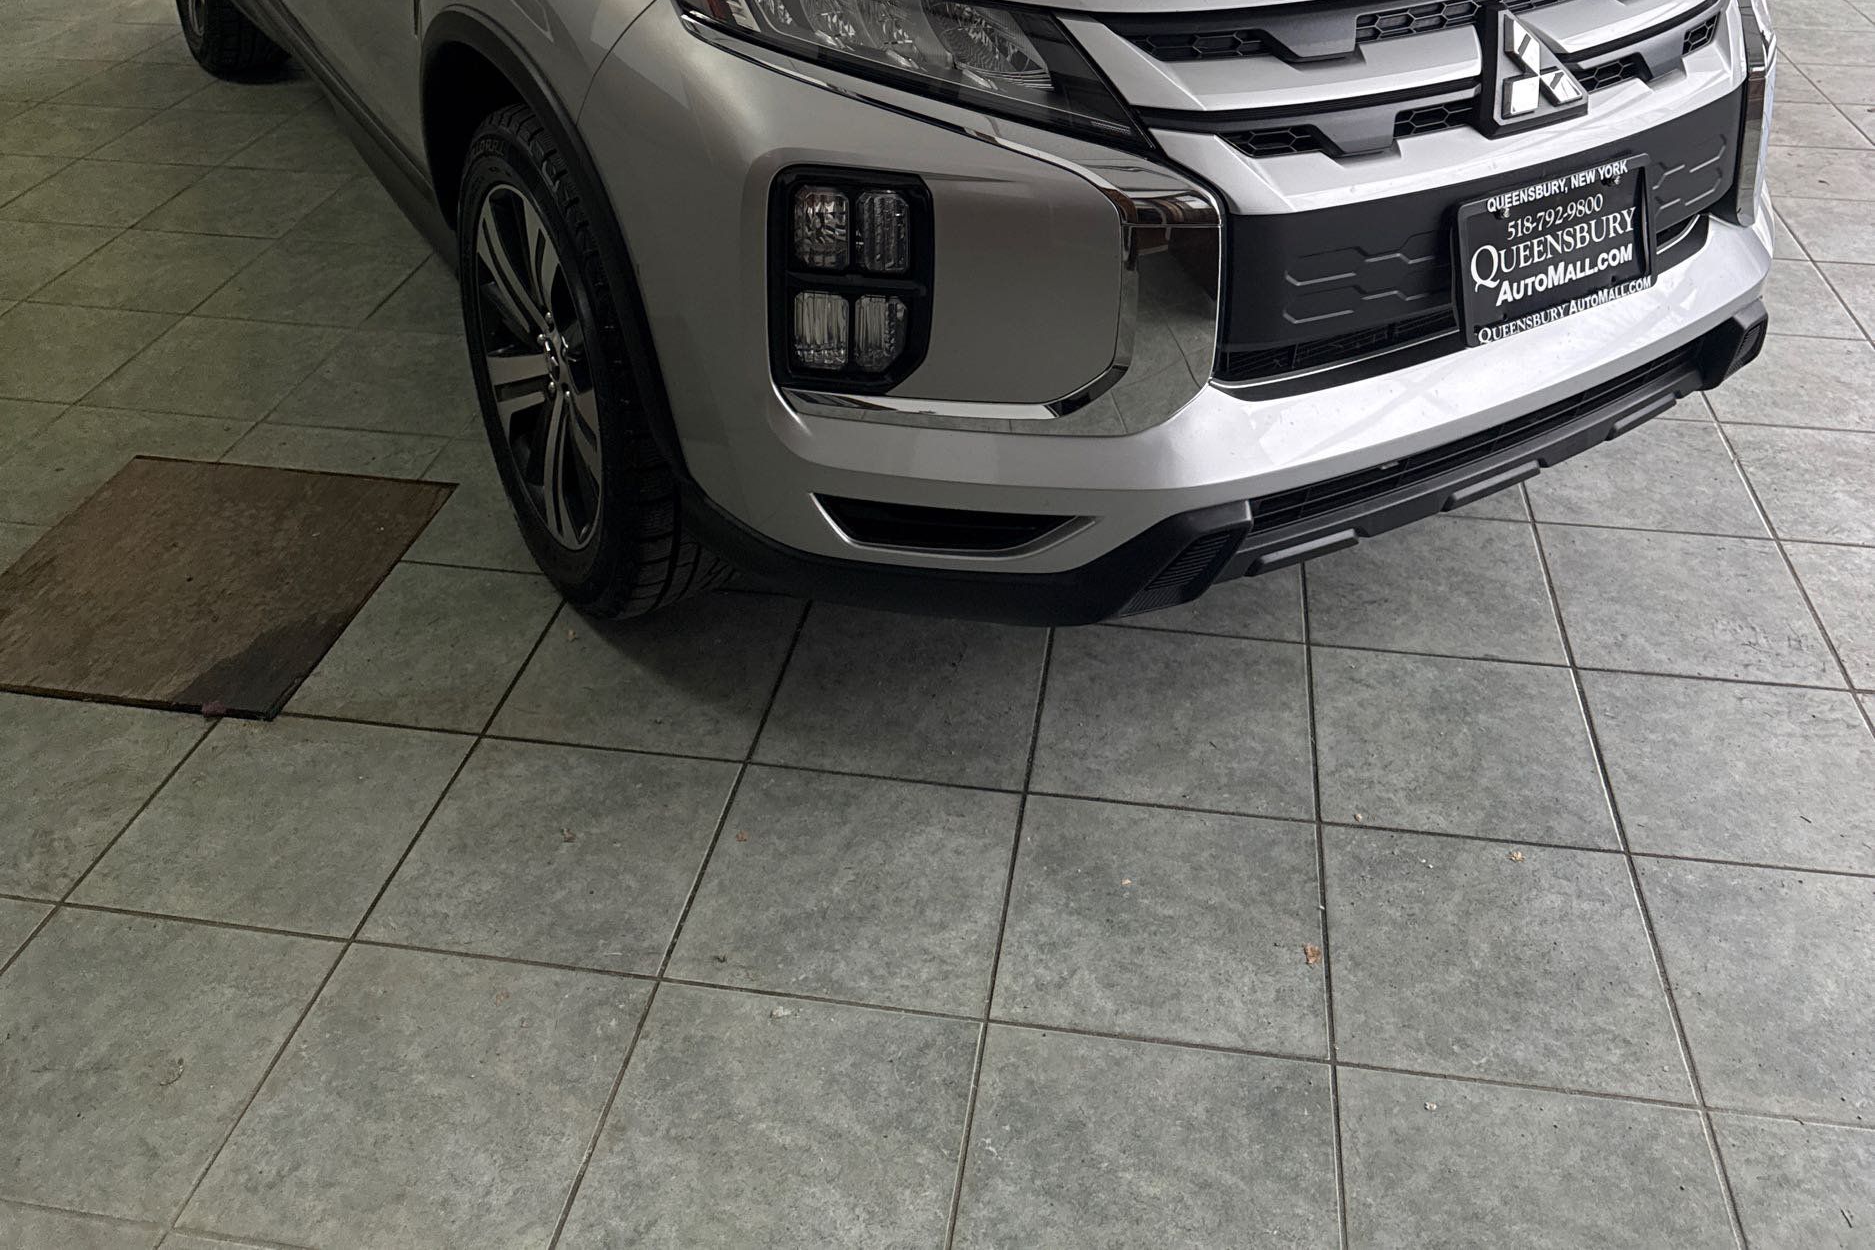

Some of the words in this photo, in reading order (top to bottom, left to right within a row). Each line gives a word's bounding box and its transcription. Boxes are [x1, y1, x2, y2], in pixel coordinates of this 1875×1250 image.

[1487, 178, 1568, 213] QUEENSBURY,
[1570, 169, 1596, 189] NEW
[1598, 160, 1628, 181] YORK
[1507, 193, 1604, 240] 518-792-9800
[1470, 206, 1636, 293] QUEENSBURY
[1478, 304, 1568, 345] QUEENSBURY
